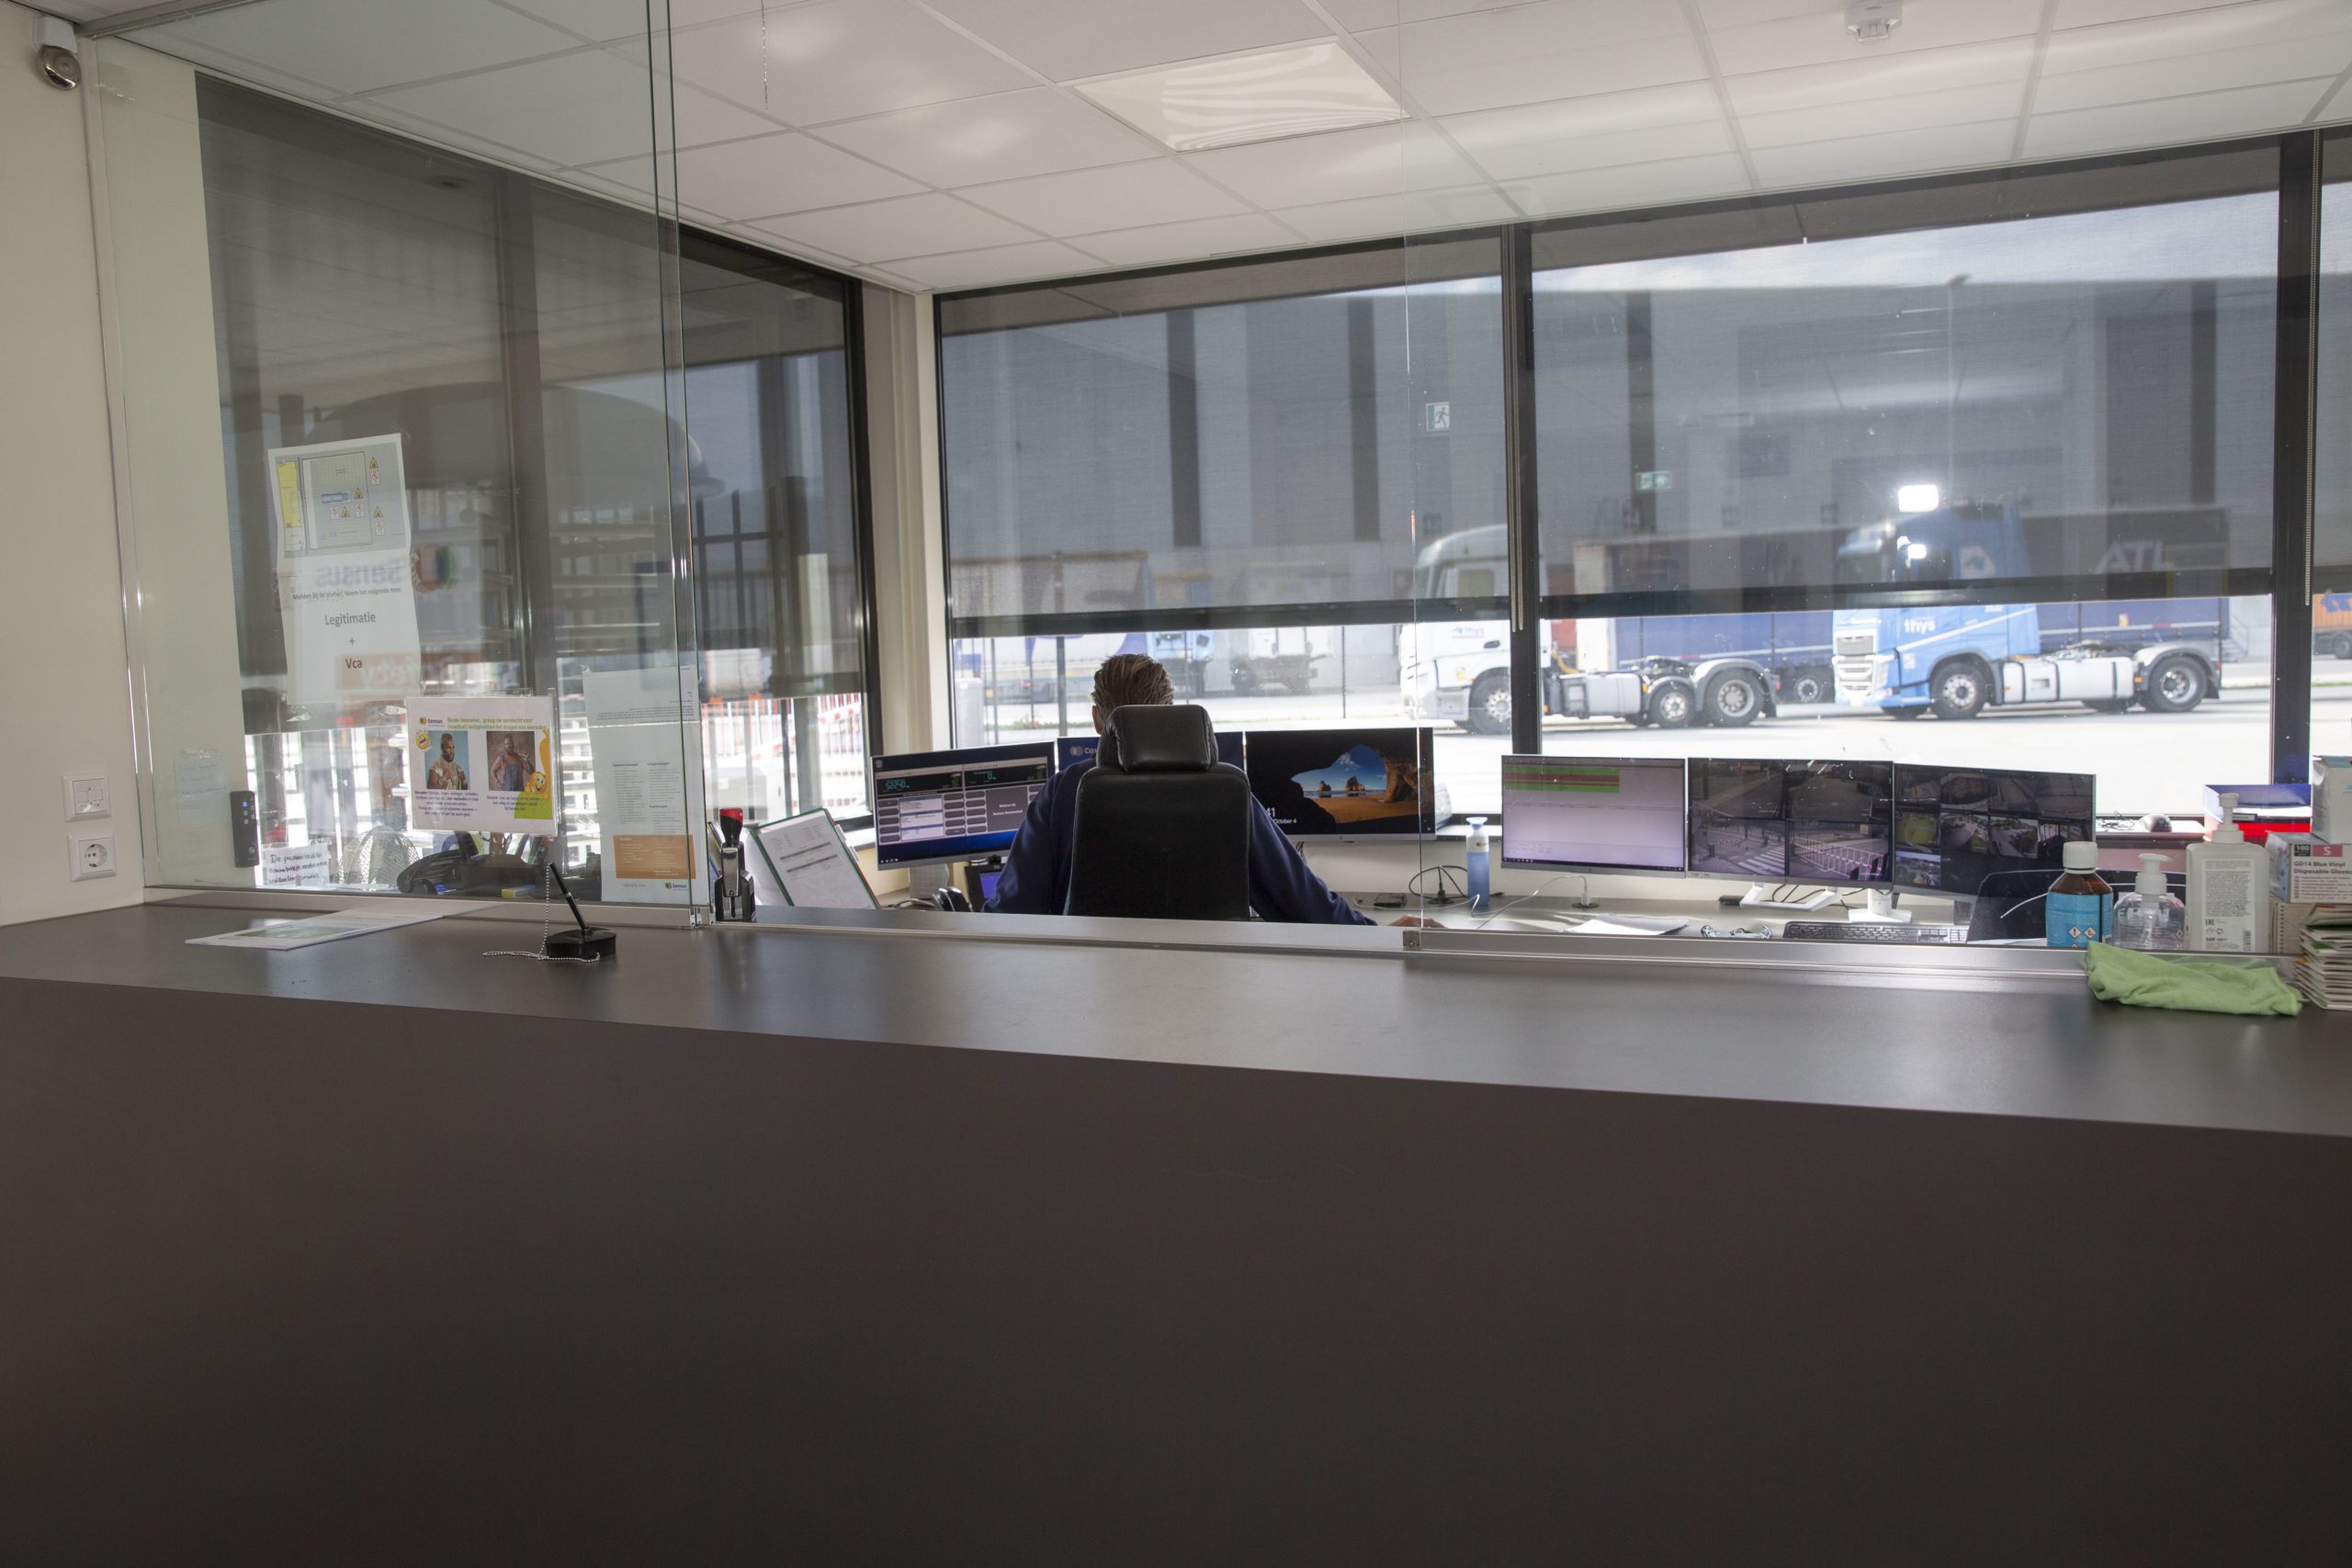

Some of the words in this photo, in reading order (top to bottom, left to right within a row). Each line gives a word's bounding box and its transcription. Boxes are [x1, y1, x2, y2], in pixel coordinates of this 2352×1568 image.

[324, 611, 376, 627] Legitimatie
[1904, 617, 1937, 635] thys
[345, 658, 363, 670] Vca
[2323, 846, 2332, 856] S
[2328, 861, 2346, 869] Vinyl
